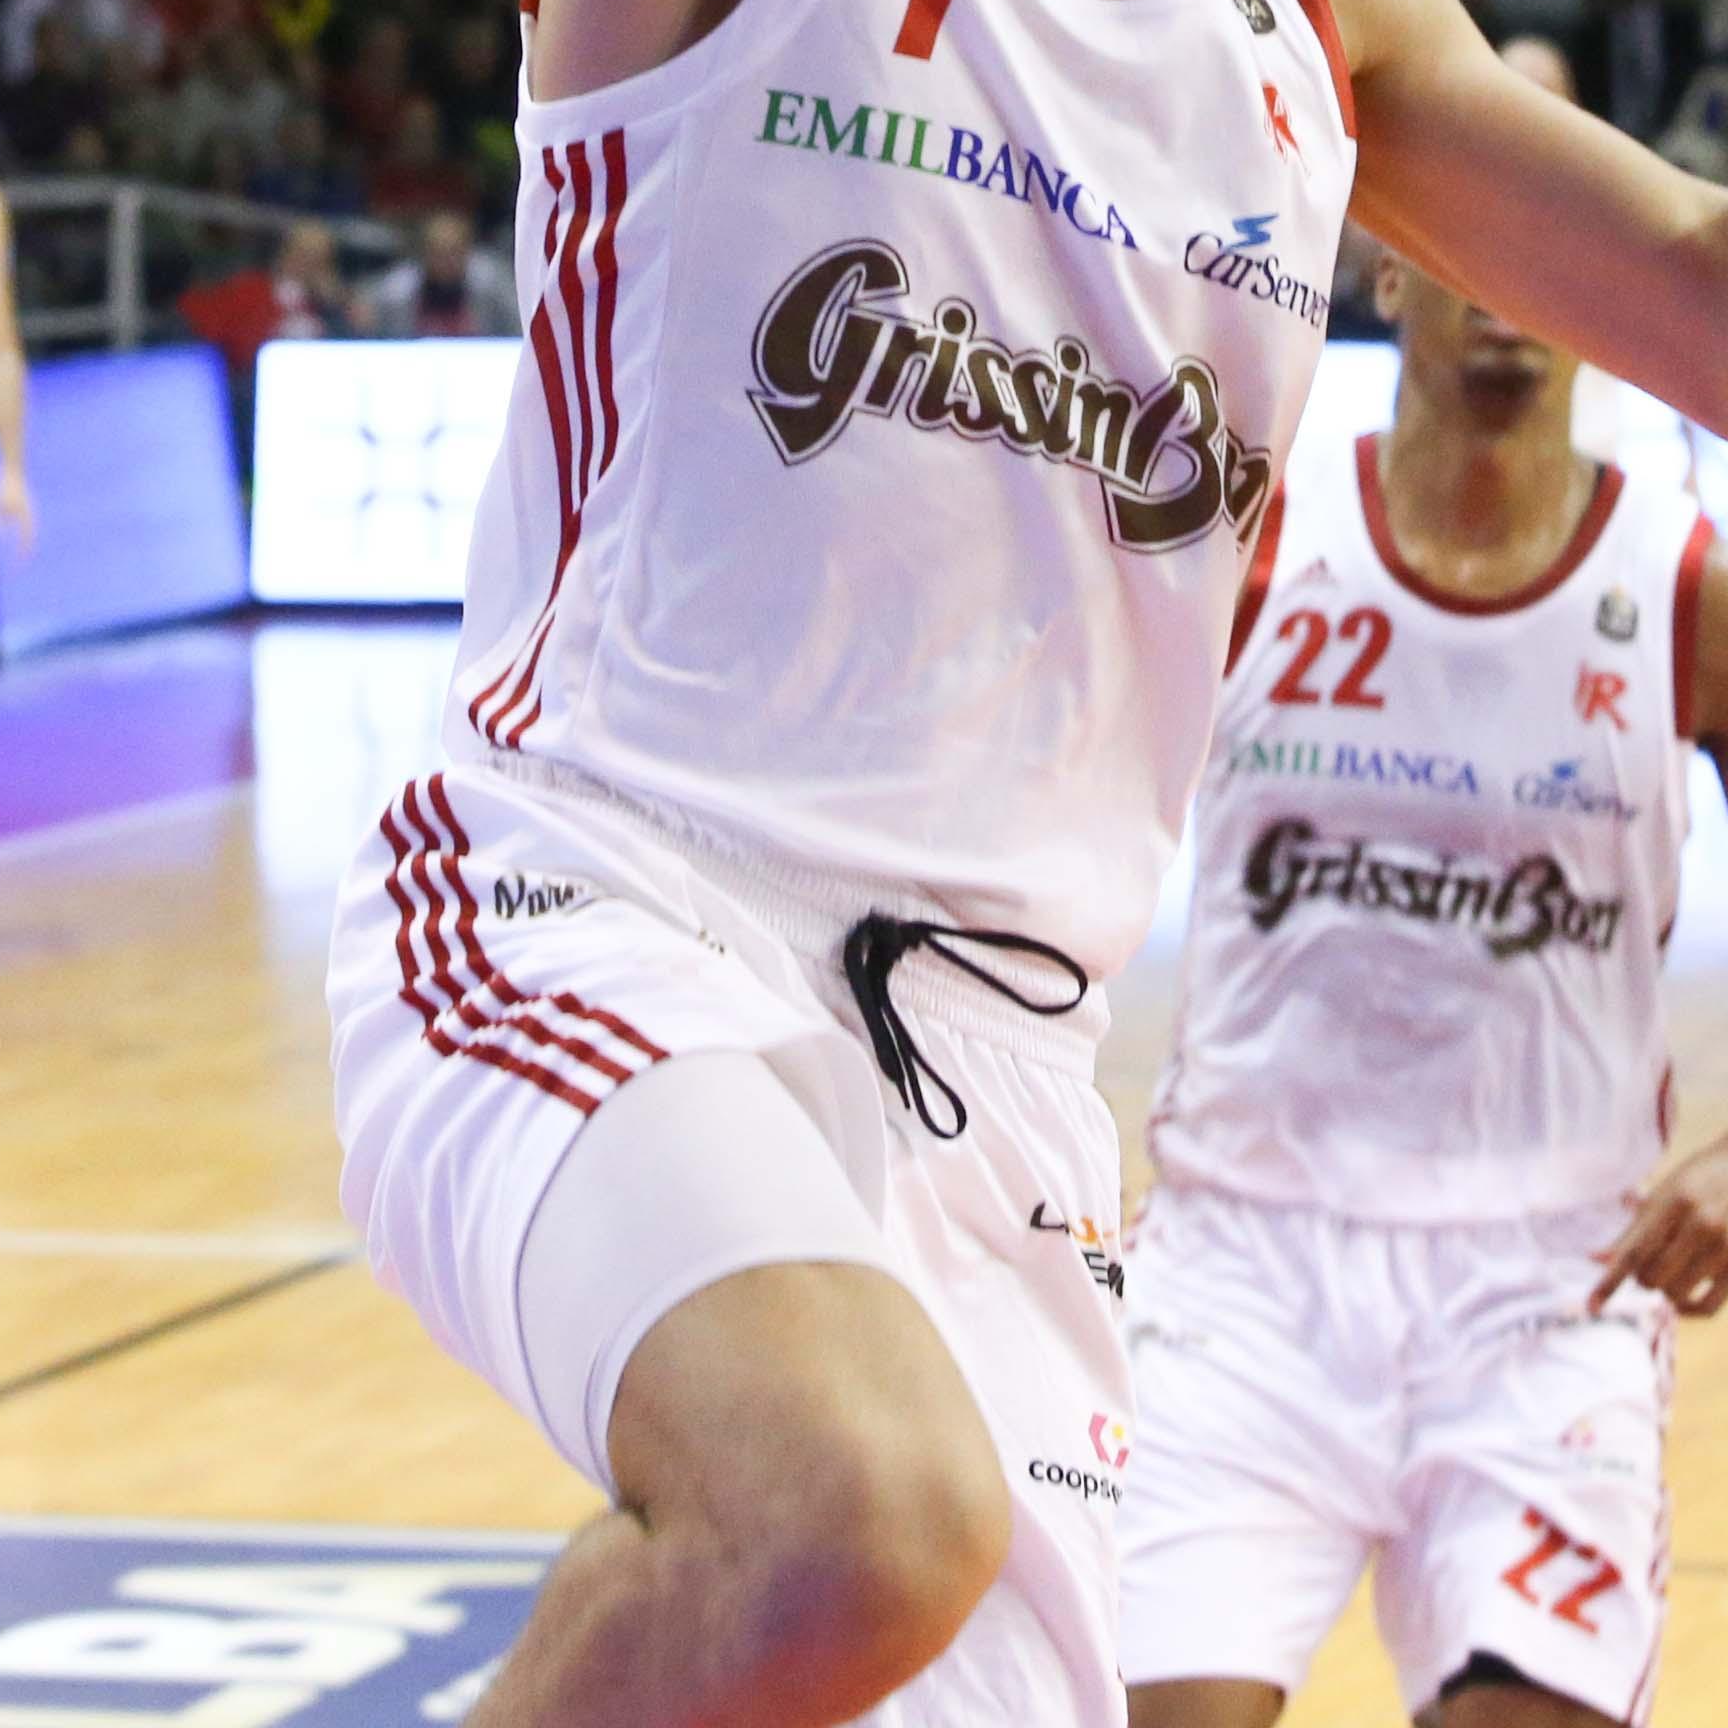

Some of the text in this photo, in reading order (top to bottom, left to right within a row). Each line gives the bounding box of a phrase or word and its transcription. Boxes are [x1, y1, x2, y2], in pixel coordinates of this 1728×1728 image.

[755, 89, 1140, 252] EMILBANCA
[1268, 606, 1393, 709] 22
[1242, 815, 1624, 962] GrissinBon
[1502, 1505, 1622, 1636] 22
